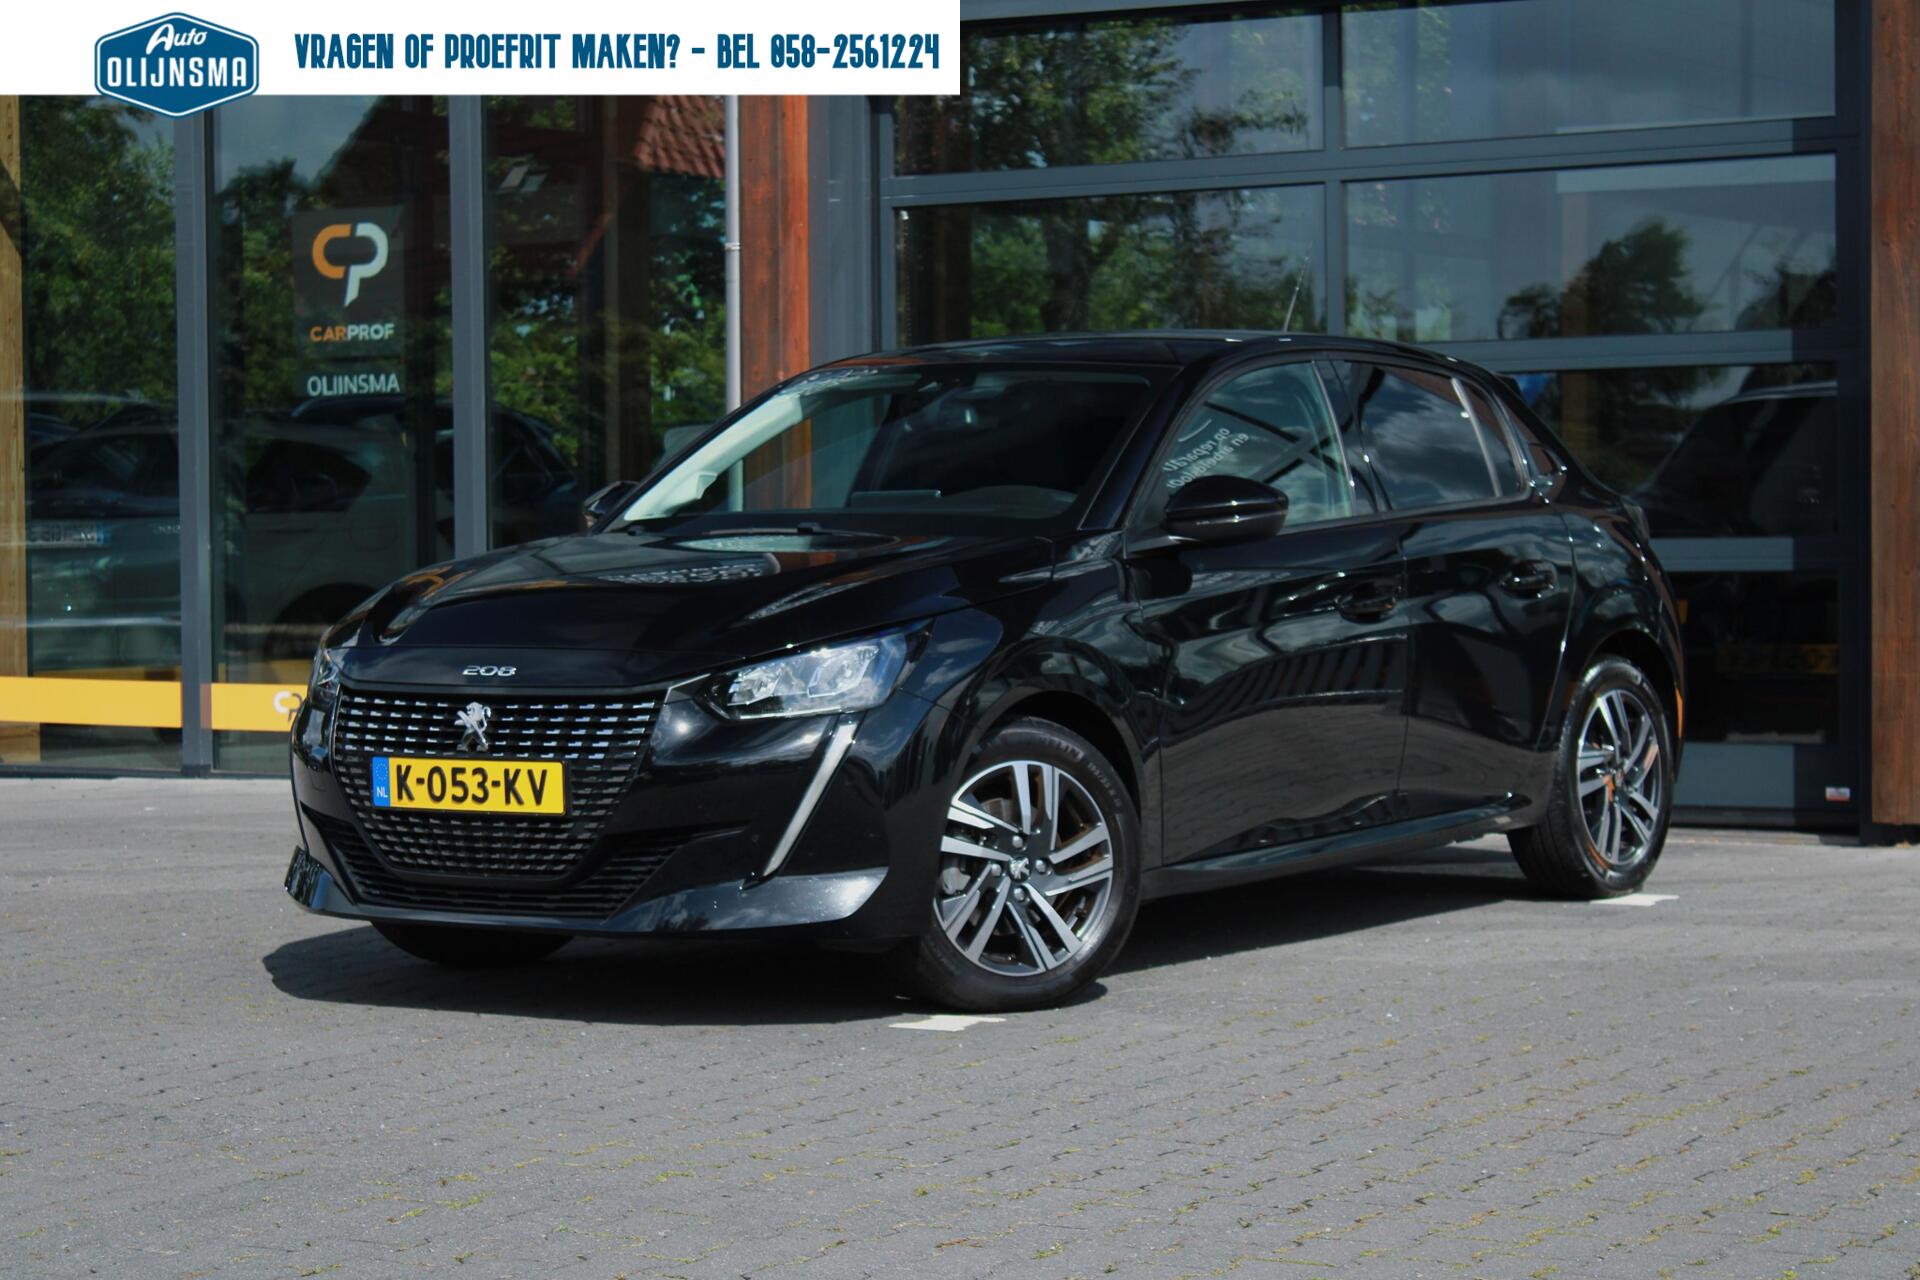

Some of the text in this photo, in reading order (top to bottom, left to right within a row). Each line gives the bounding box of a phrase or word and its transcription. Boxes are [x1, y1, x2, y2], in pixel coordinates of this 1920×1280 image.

[310, 323, 395, 342] CARPROF
[462, 664, 517, 677] 208
[376, 786, 388, 798] NL
[396, 764, 547, 806] K-053-KV
